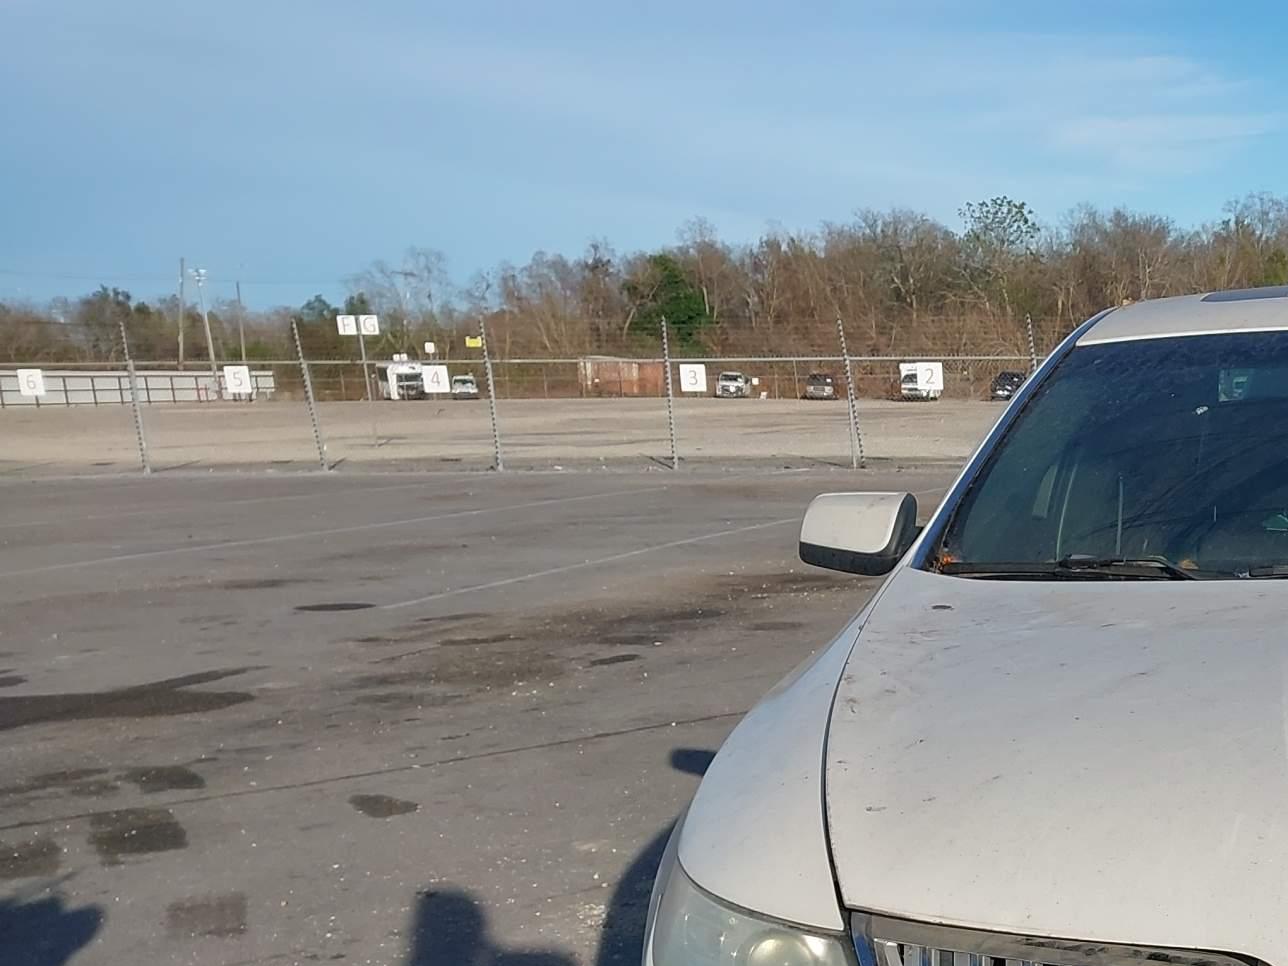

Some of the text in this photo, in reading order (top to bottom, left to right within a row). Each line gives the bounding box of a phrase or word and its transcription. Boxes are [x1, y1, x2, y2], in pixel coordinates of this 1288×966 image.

[341, 316, 353, 333] F
[363, 316, 376, 332] G
[26, 374, 37, 390] 6
[232, 371, 243, 387] 5
[431, 370, 441, 385] 4
[688, 369, 698, 386] 3
[925, 368, 936, 385] 2
